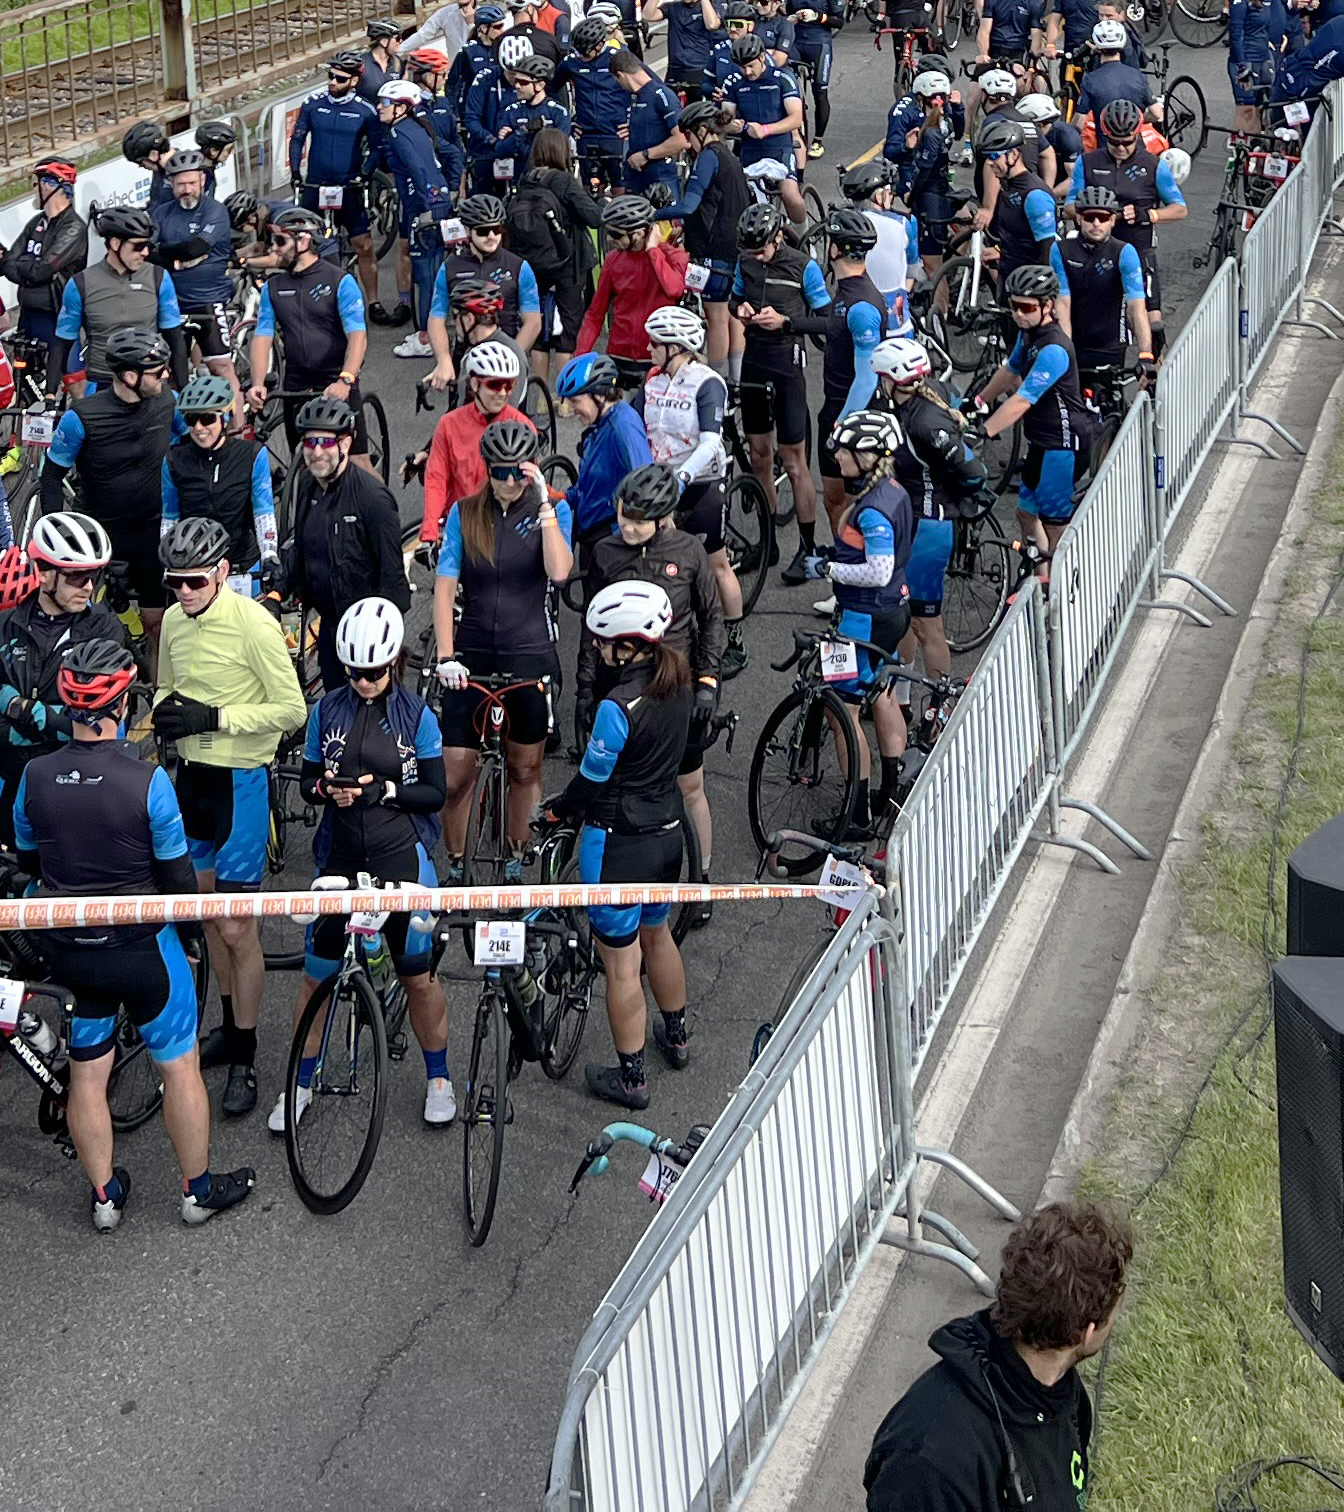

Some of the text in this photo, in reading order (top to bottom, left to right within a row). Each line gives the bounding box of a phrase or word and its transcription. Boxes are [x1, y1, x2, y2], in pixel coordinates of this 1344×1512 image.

[656, 397, 692, 410] GIRO
[488, 940, 511, 952] 214E
[10, 1036, 51, 1083] ARGON
[661, 1165, 681, 1183] 176
